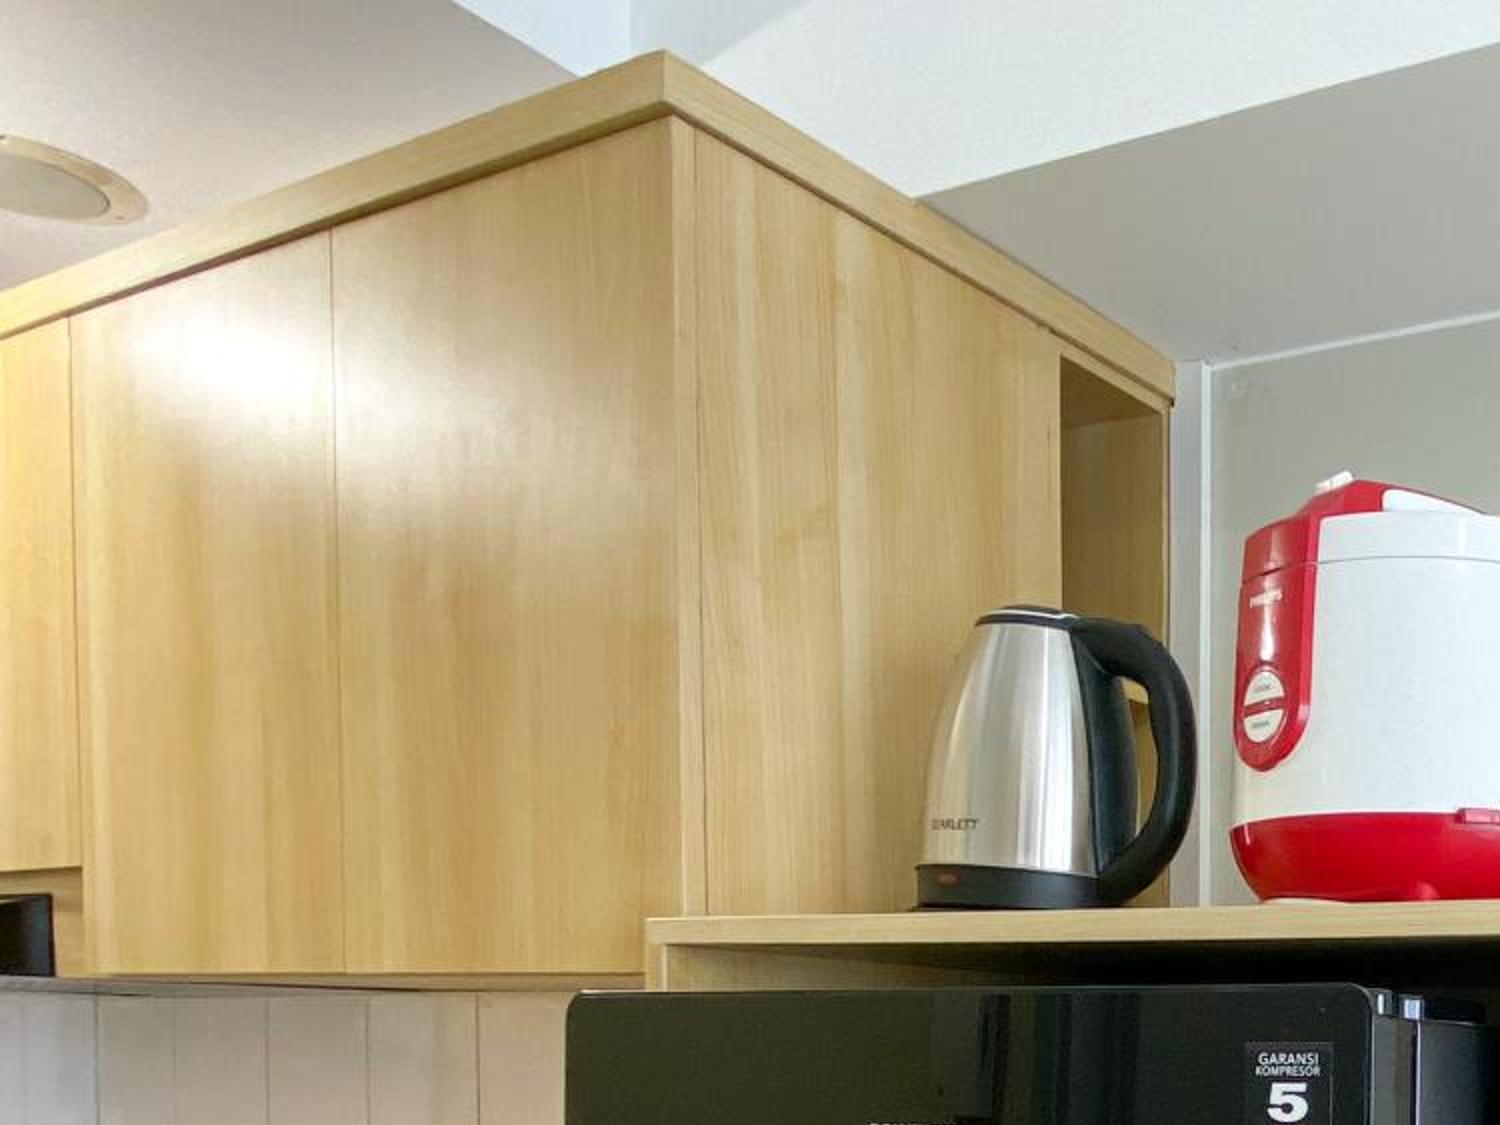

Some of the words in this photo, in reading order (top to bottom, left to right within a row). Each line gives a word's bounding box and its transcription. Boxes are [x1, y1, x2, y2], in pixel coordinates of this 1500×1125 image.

[1258, 1052, 1320, 1066] GARANSI
[1255, 1065, 1321, 1077] KOMPRESOR
[1267, 1082, 1309, 1124] 5
